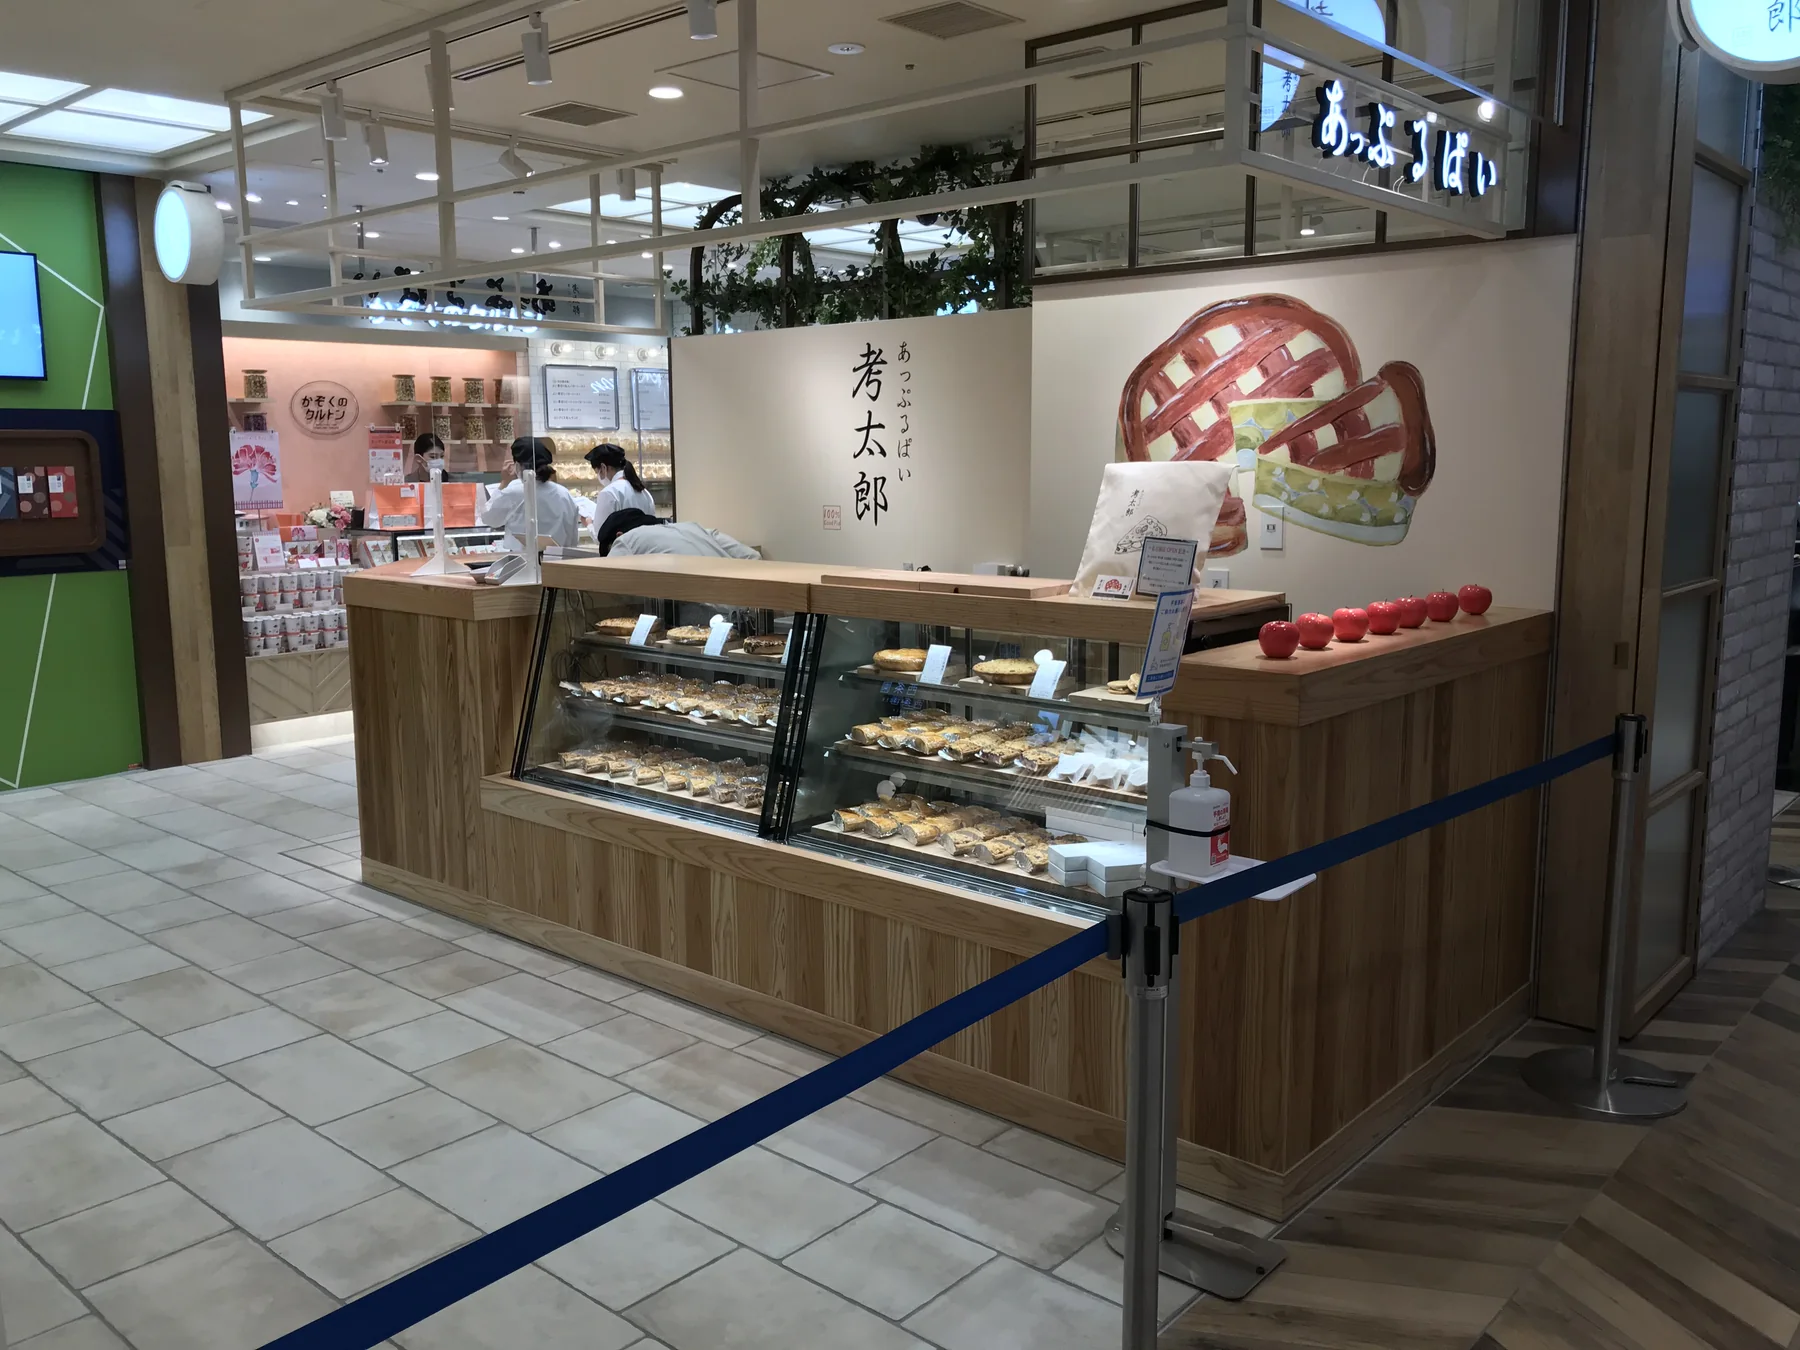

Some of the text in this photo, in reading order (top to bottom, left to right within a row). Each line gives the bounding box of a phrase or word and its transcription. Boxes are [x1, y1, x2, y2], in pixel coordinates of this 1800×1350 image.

[1320, 79, 1497, 196] あっぷるぱい
[301, 395, 348, 408] かぞくの
[305, 408, 346, 421] クルトン
[852, 342, 888, 526] 考太郎
[897, 340, 912, 482] あっぷるぱい
[1125, 488, 1139, 517] 考太郎
